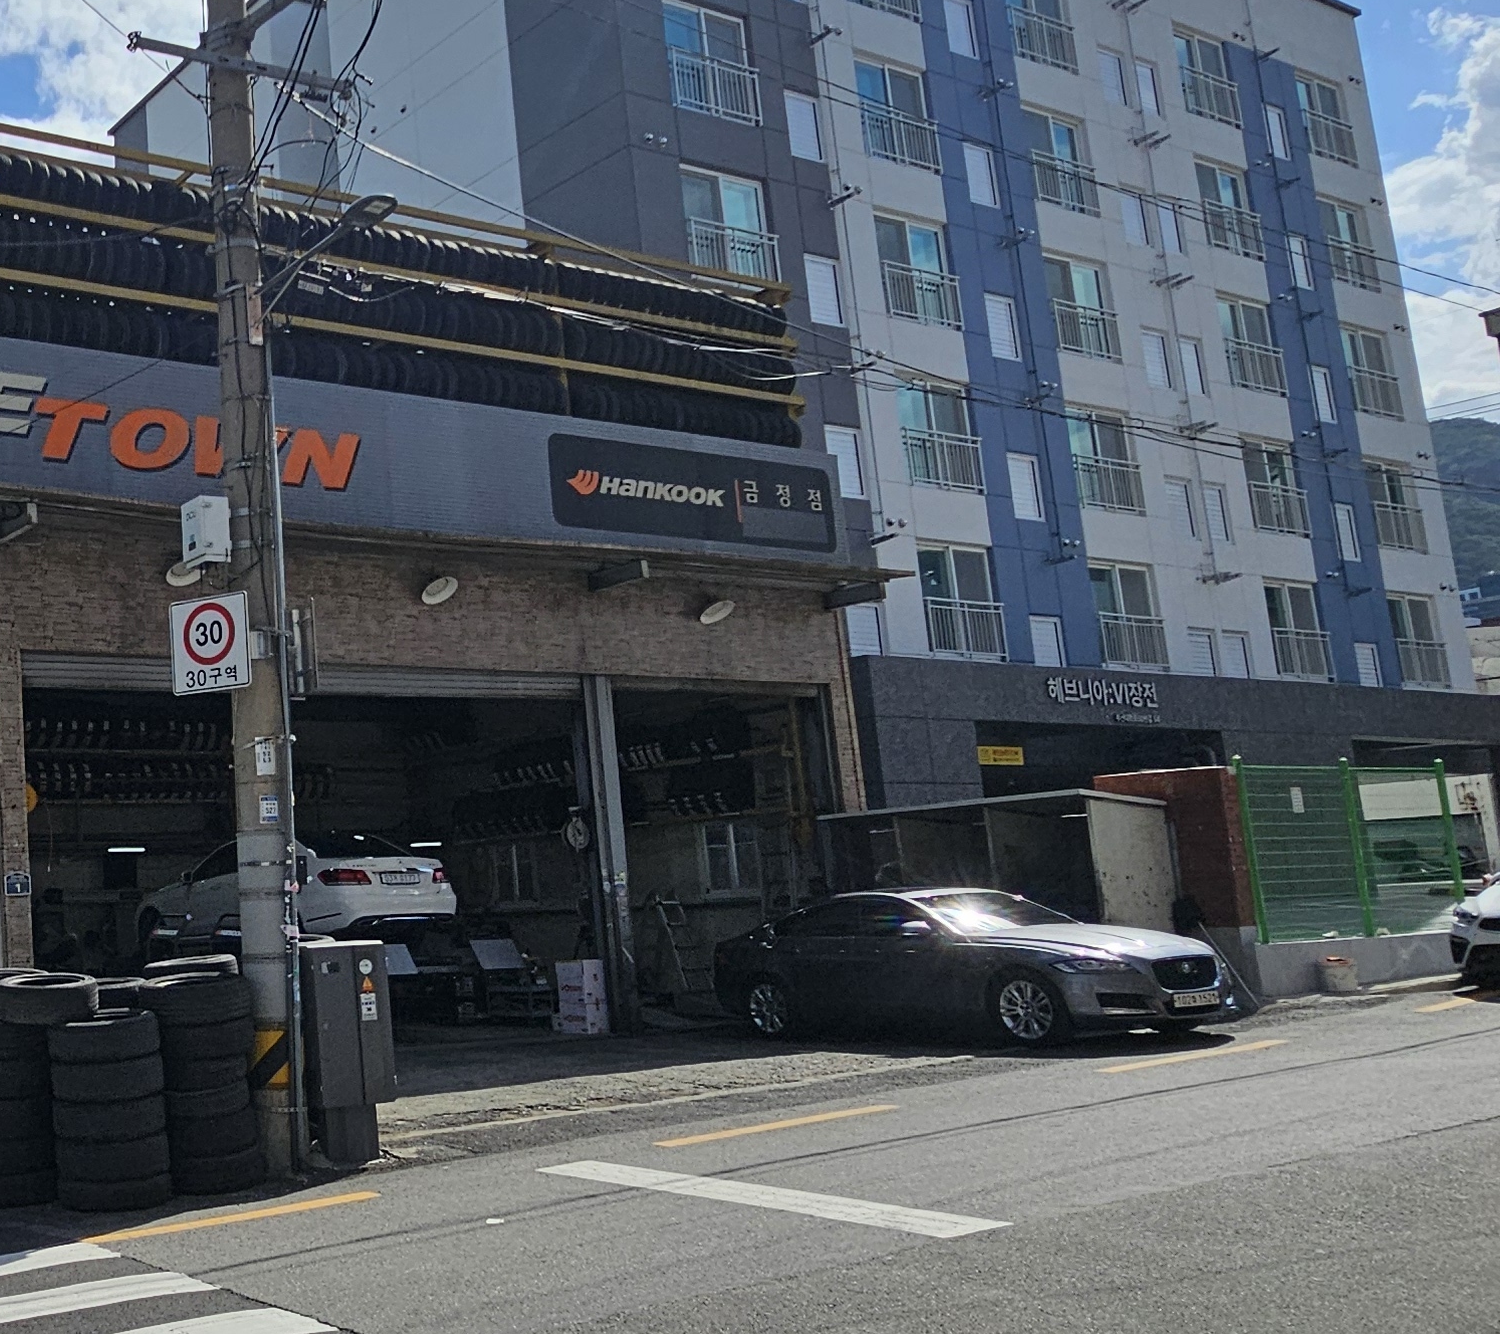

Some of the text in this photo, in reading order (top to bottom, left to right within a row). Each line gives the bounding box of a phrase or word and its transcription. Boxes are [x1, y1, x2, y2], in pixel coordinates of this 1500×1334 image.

[195, 620, 223, 647] 30
[186, 665, 238, 688] 30구역
[15, 883, 21, 893] 1
